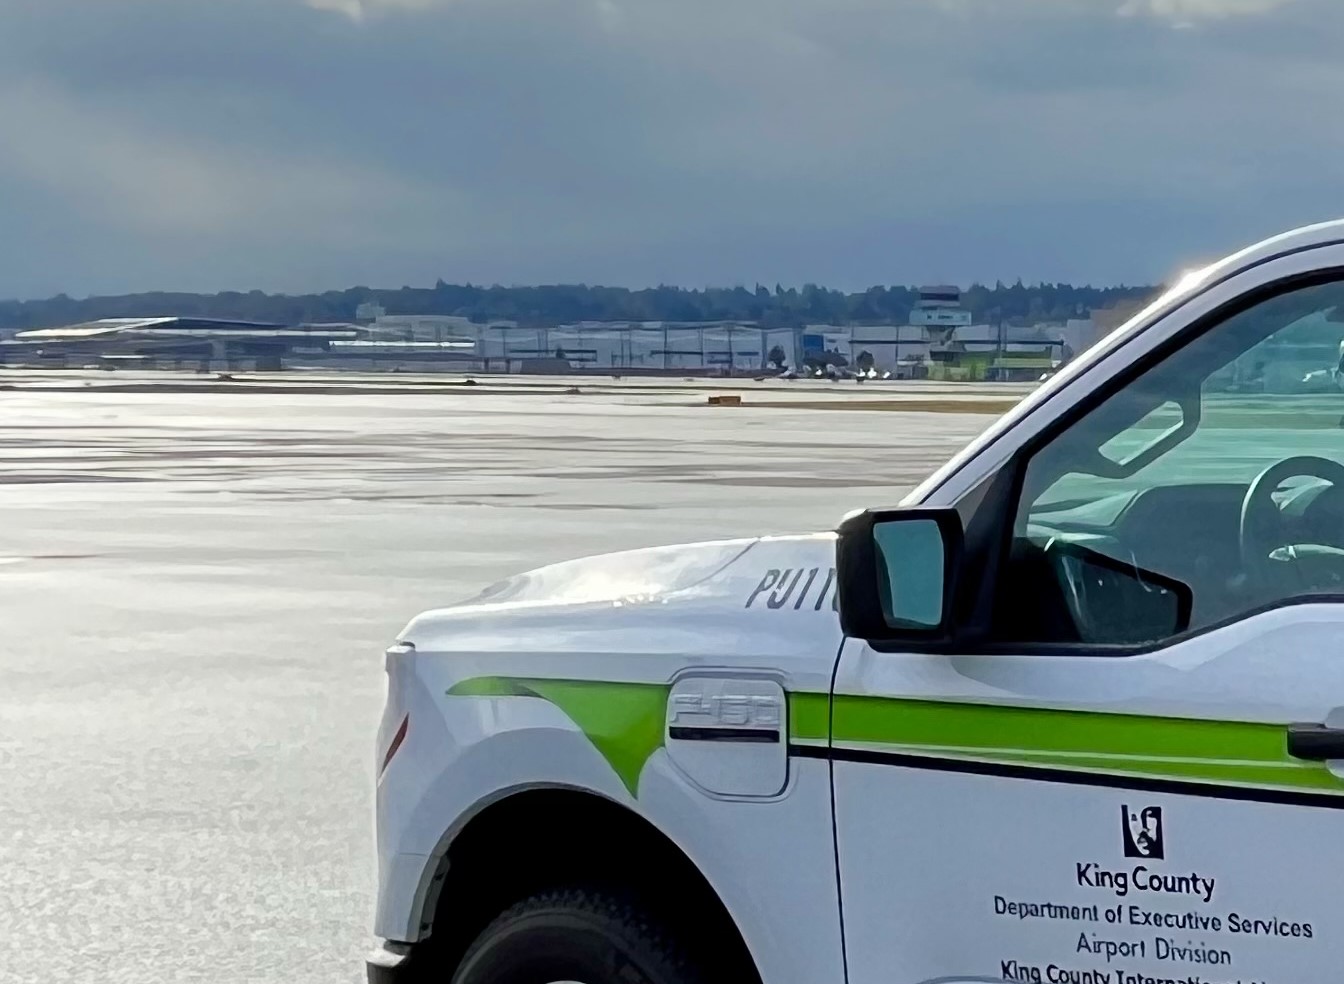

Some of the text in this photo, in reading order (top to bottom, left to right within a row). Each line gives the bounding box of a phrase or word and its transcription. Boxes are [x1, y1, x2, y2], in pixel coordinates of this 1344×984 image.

[1076, 862, 1214, 902] King County
[994, 896, 1313, 938] Department of Executive Services
[1076, 932, 1231, 965] Airport Division
[1001, 960, 1042, 984] King
